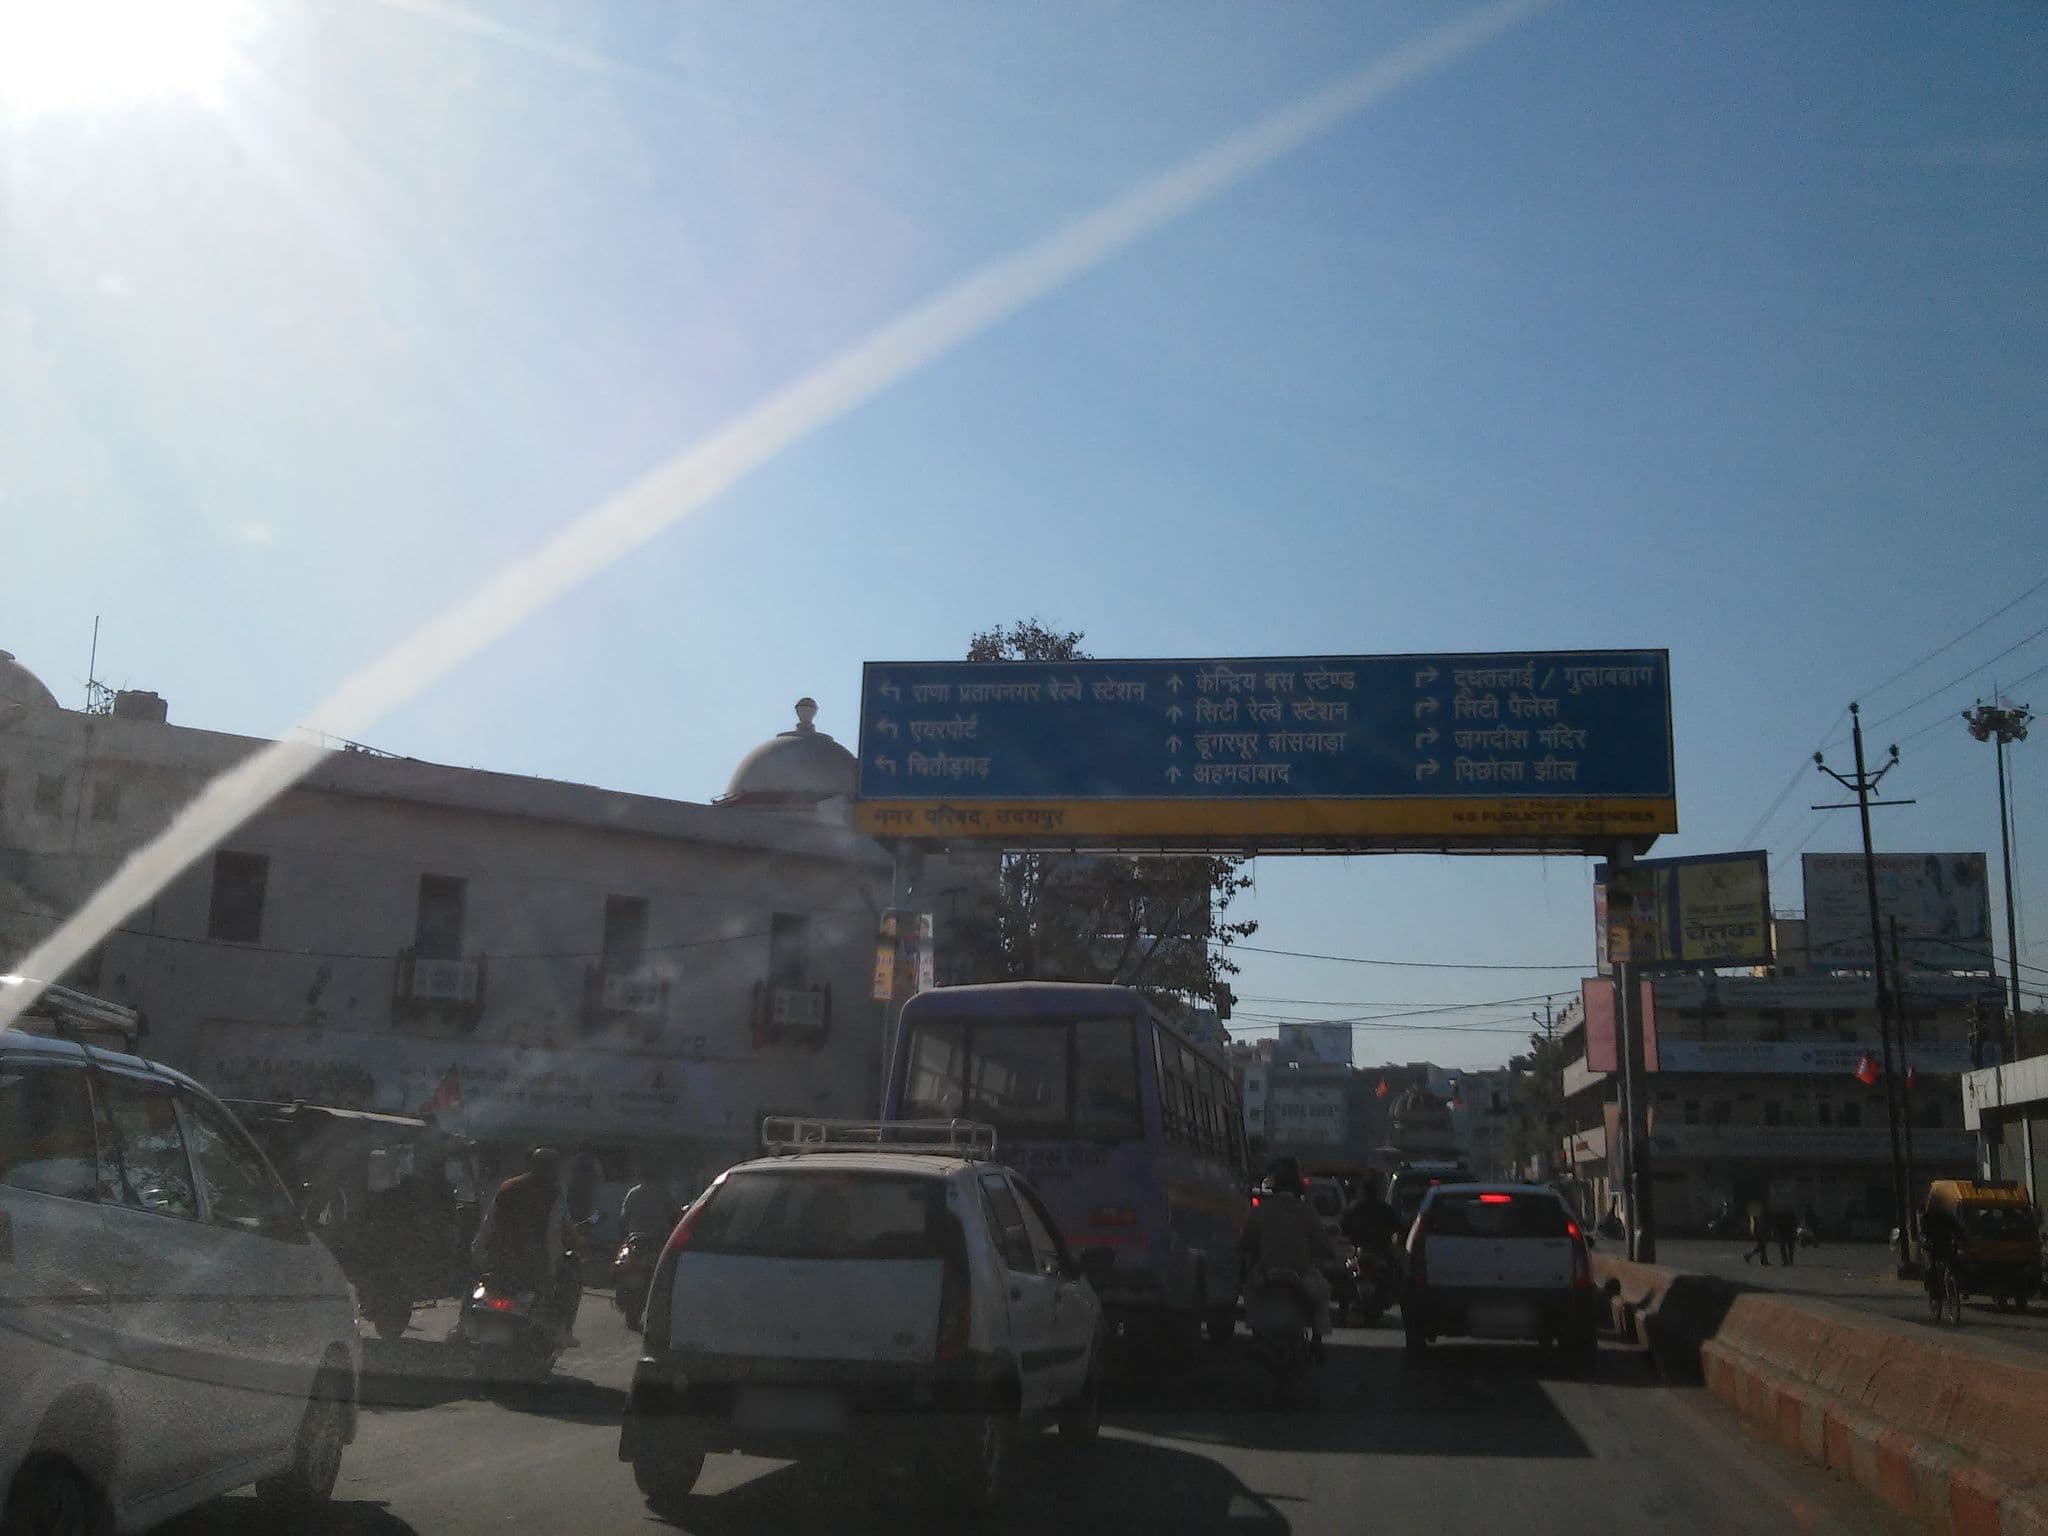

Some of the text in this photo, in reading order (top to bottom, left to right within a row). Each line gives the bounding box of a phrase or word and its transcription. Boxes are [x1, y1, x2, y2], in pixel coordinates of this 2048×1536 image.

[1264, 672, 1296, 693] बस
[1563, 665, 1655, 694] गुलाबबाग
[912, 682, 951, 704] राणा
[1453, 692, 1499, 719] सिटी
[1195, 697, 1239, 723] सिटी
[1452, 722, 1587, 751] जगदीश मंदिर
[1193, 762, 1292, 785] अहमदाबाद
[1453, 754, 1579, 782] पिछोला झील
[873, 808, 913, 826] नगर
[995, 808, 1065, 832] उदयपुर
